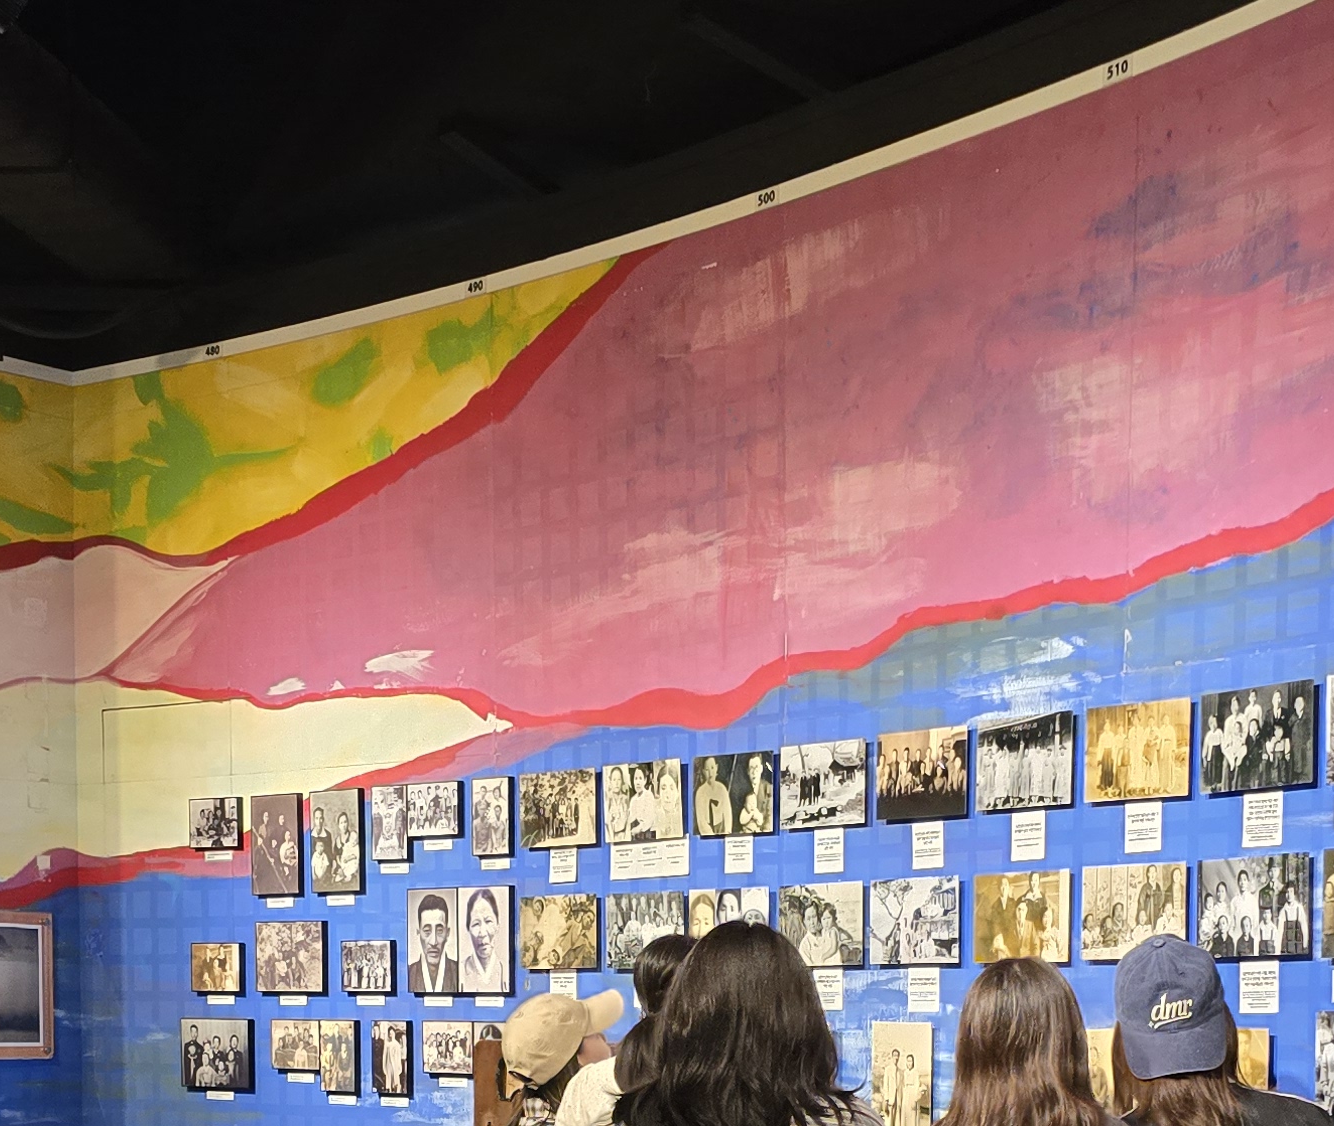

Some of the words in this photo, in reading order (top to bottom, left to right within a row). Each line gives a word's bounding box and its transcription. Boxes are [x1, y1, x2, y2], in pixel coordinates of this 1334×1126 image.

[1106, 59, 1129, 80] 510
[757, 190, 776, 207] 500
[467, 279, 484, 294] 490
[204, 344, 221, 358] 480
